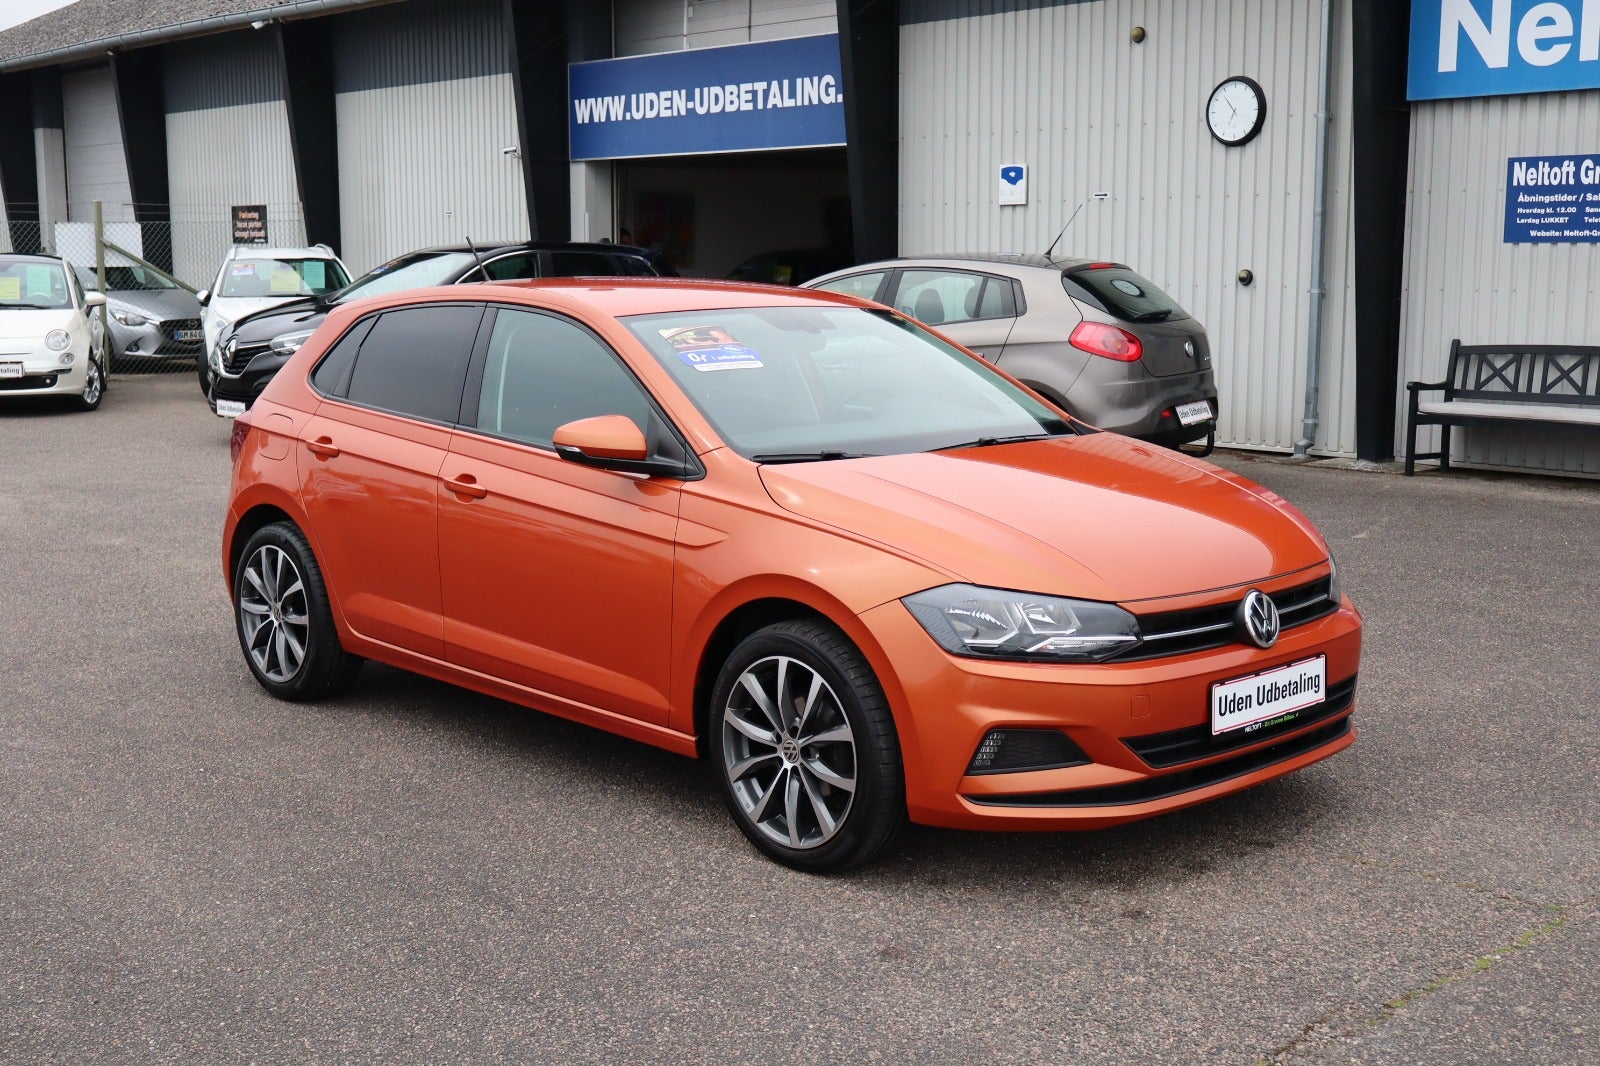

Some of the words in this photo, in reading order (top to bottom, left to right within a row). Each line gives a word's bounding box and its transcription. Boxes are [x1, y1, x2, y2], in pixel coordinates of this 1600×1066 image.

[574, 74, 843, 124] WWW.UDEN-UDBETALING.
[1513, 160, 1575, 186] Neltoft
[1517, 192, 1578, 203] Åbningstider
[1541, 216, 1569, 224] LUKKET
[1530, 229, 1562, 237] Website:
[1218, 692, 1252, 717] Uden
[1256, 672, 1321, 706] Udbetaling
